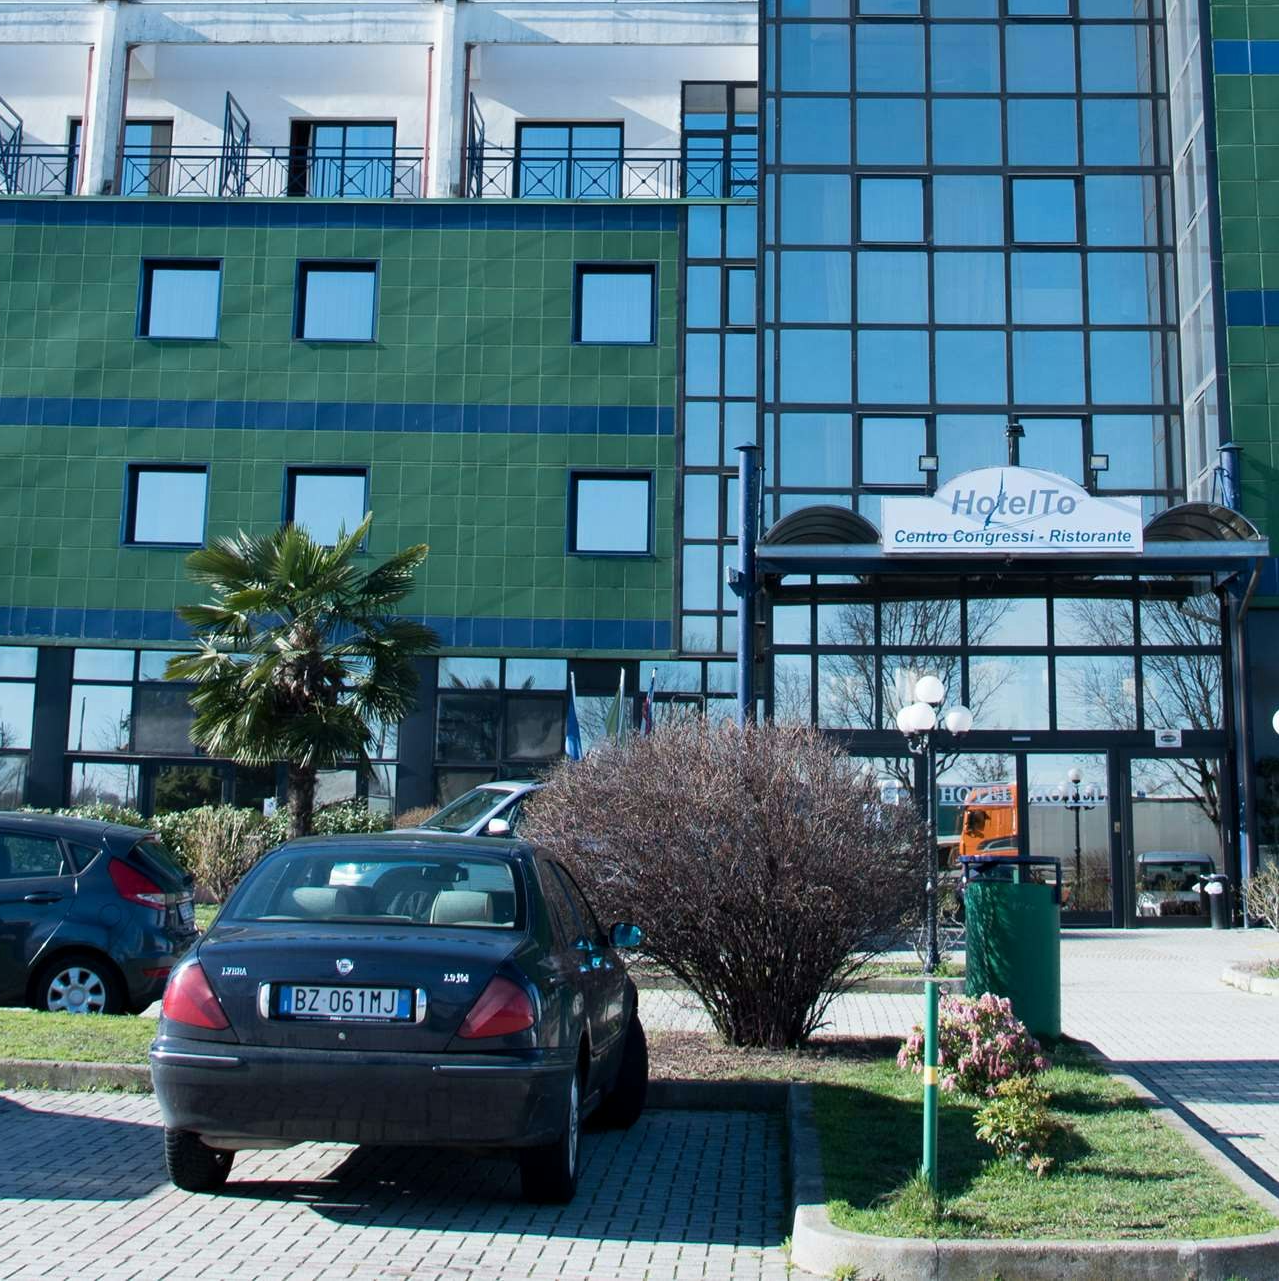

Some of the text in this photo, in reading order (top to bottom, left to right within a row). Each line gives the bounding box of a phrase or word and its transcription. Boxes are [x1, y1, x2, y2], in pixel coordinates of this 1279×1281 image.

[951, 489, 1077, 516] HotelTo
[894, 529, 948, 543] Centro
[952, 529, 1035, 548] Congressi
[1049, 529, 1132, 543] Ristorante
[294, 988, 396, 1014] BZ 061MJ
